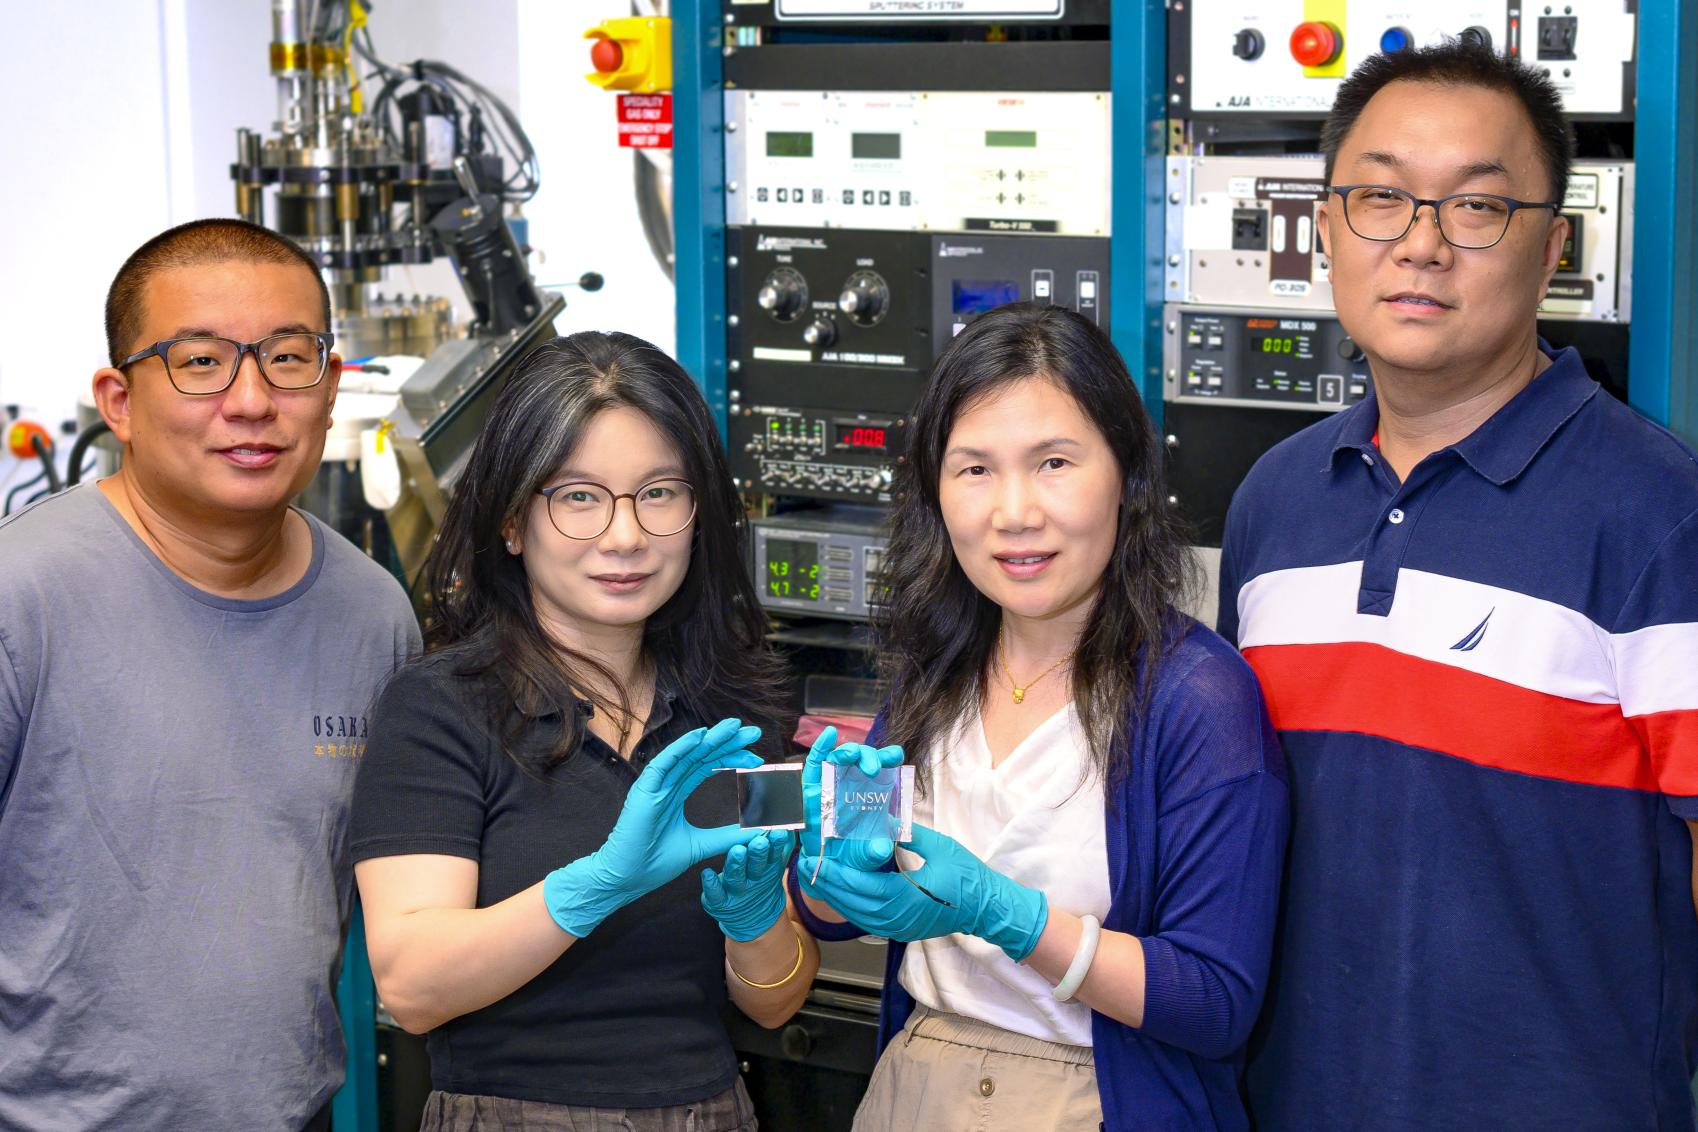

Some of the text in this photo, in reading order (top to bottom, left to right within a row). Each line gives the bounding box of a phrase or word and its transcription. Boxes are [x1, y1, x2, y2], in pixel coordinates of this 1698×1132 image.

[926, 1, 964, 10] SYSTEM
[1228, 96, 1251, 107] AJA
[1282, 183, 1325, 192] INTERNATION
[1263, 338, 1292, 353] 000
[1326, 382, 1335, 398] 5
[313, 715, 368, 738] OSAKA
[844, 792, 889, 804] UNSW
